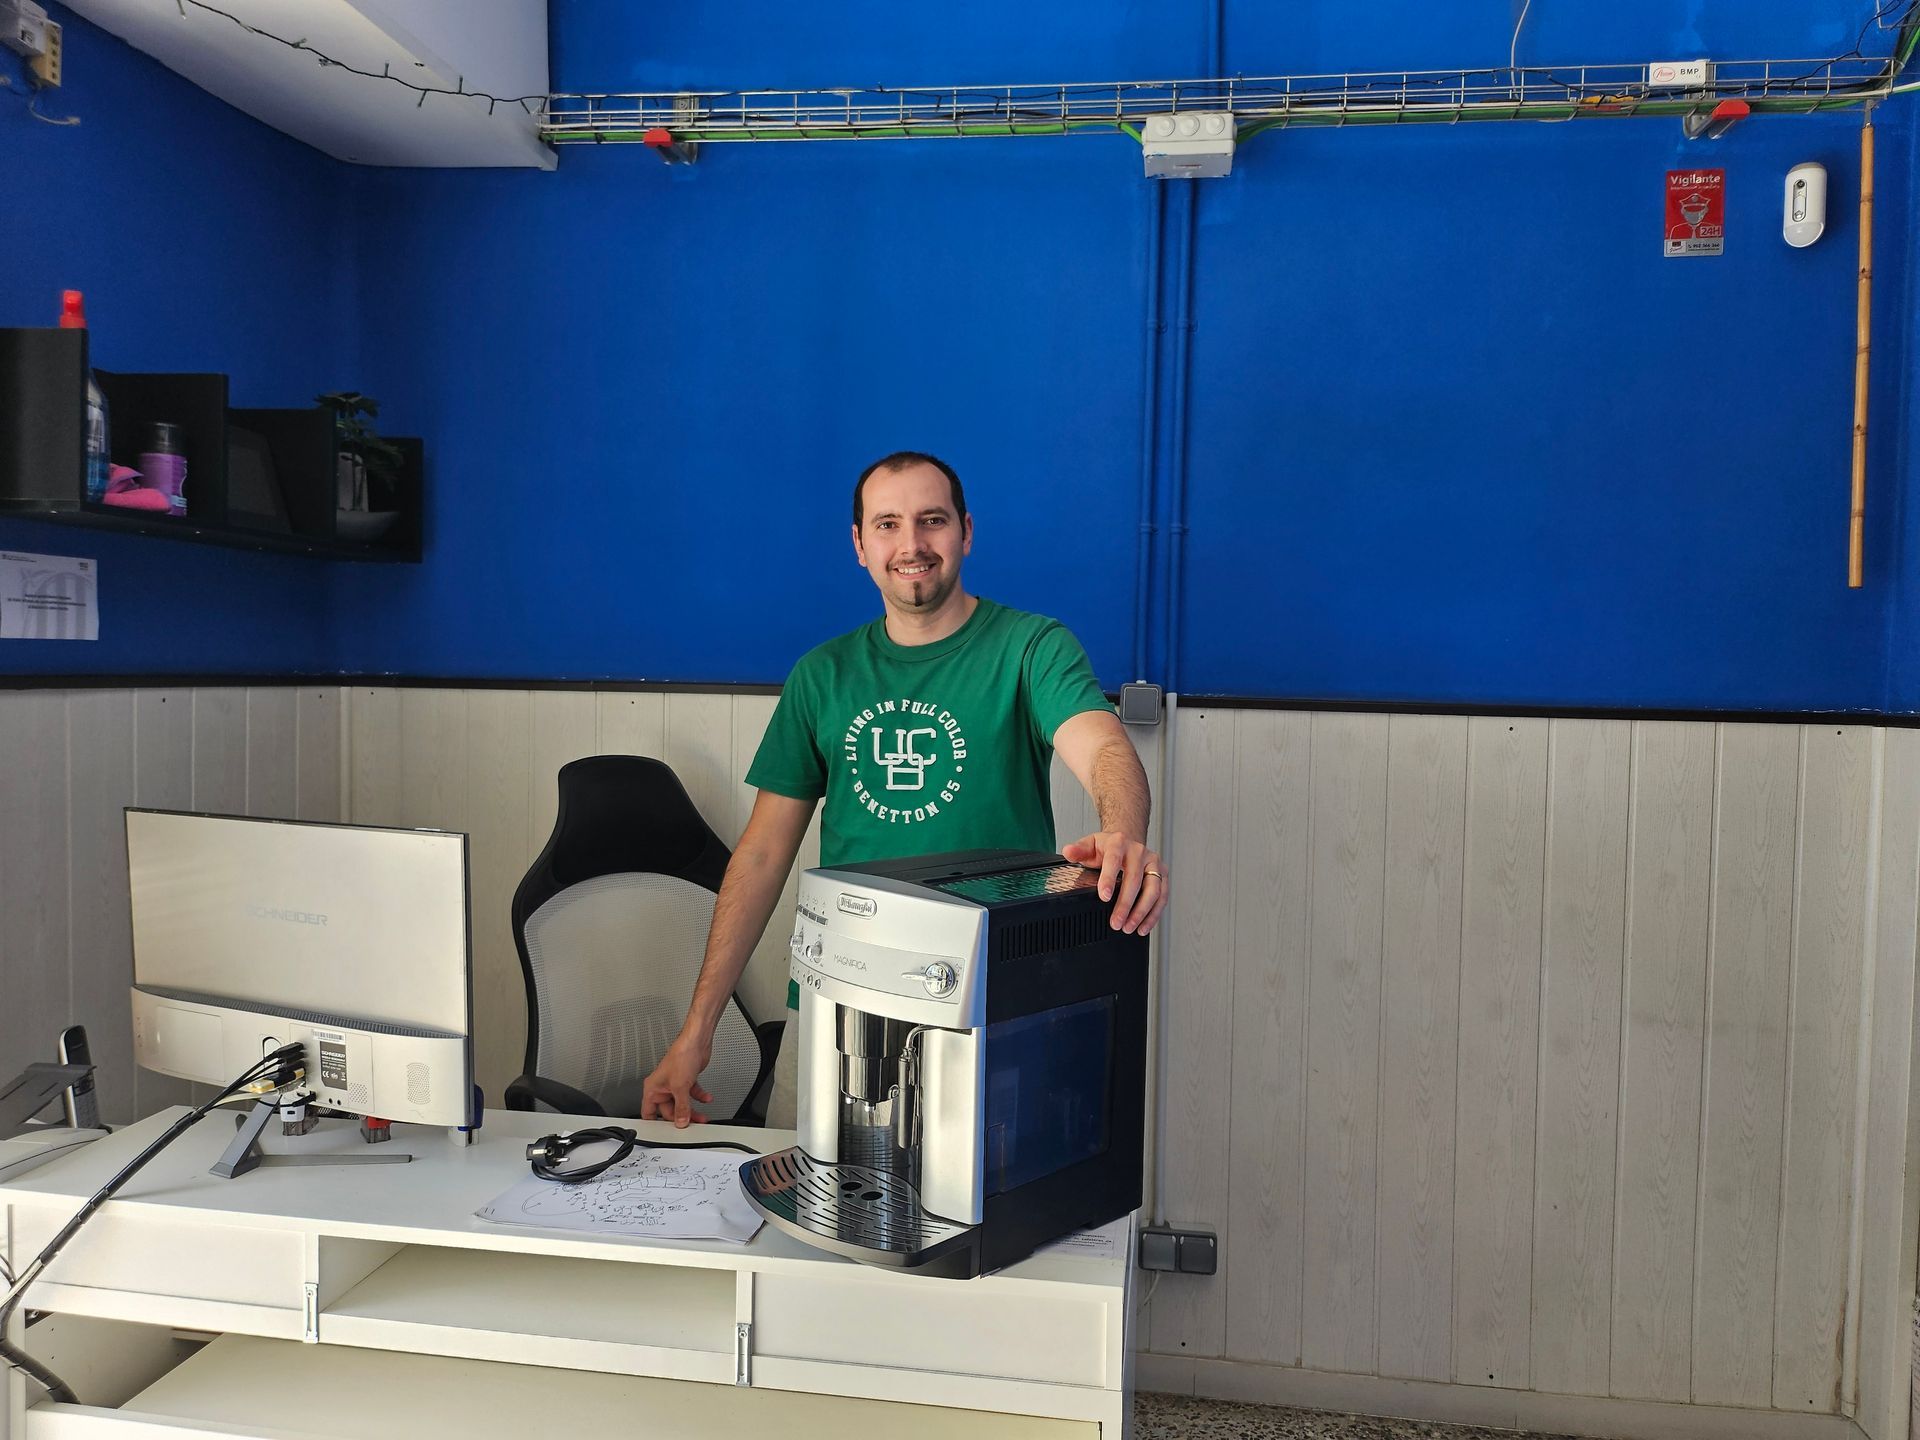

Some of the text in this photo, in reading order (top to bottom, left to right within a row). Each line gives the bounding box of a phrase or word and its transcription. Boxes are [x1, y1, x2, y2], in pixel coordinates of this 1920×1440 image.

[1670, 174, 1721, 187] Vigilante
[1701, 226, 1720, 236] 24H
[845, 699, 967, 761] LIVING IN FULL COLOR
[853, 779, 961, 824] BENETTON 65
[833, 954, 867, 971] MAGNIFICA
